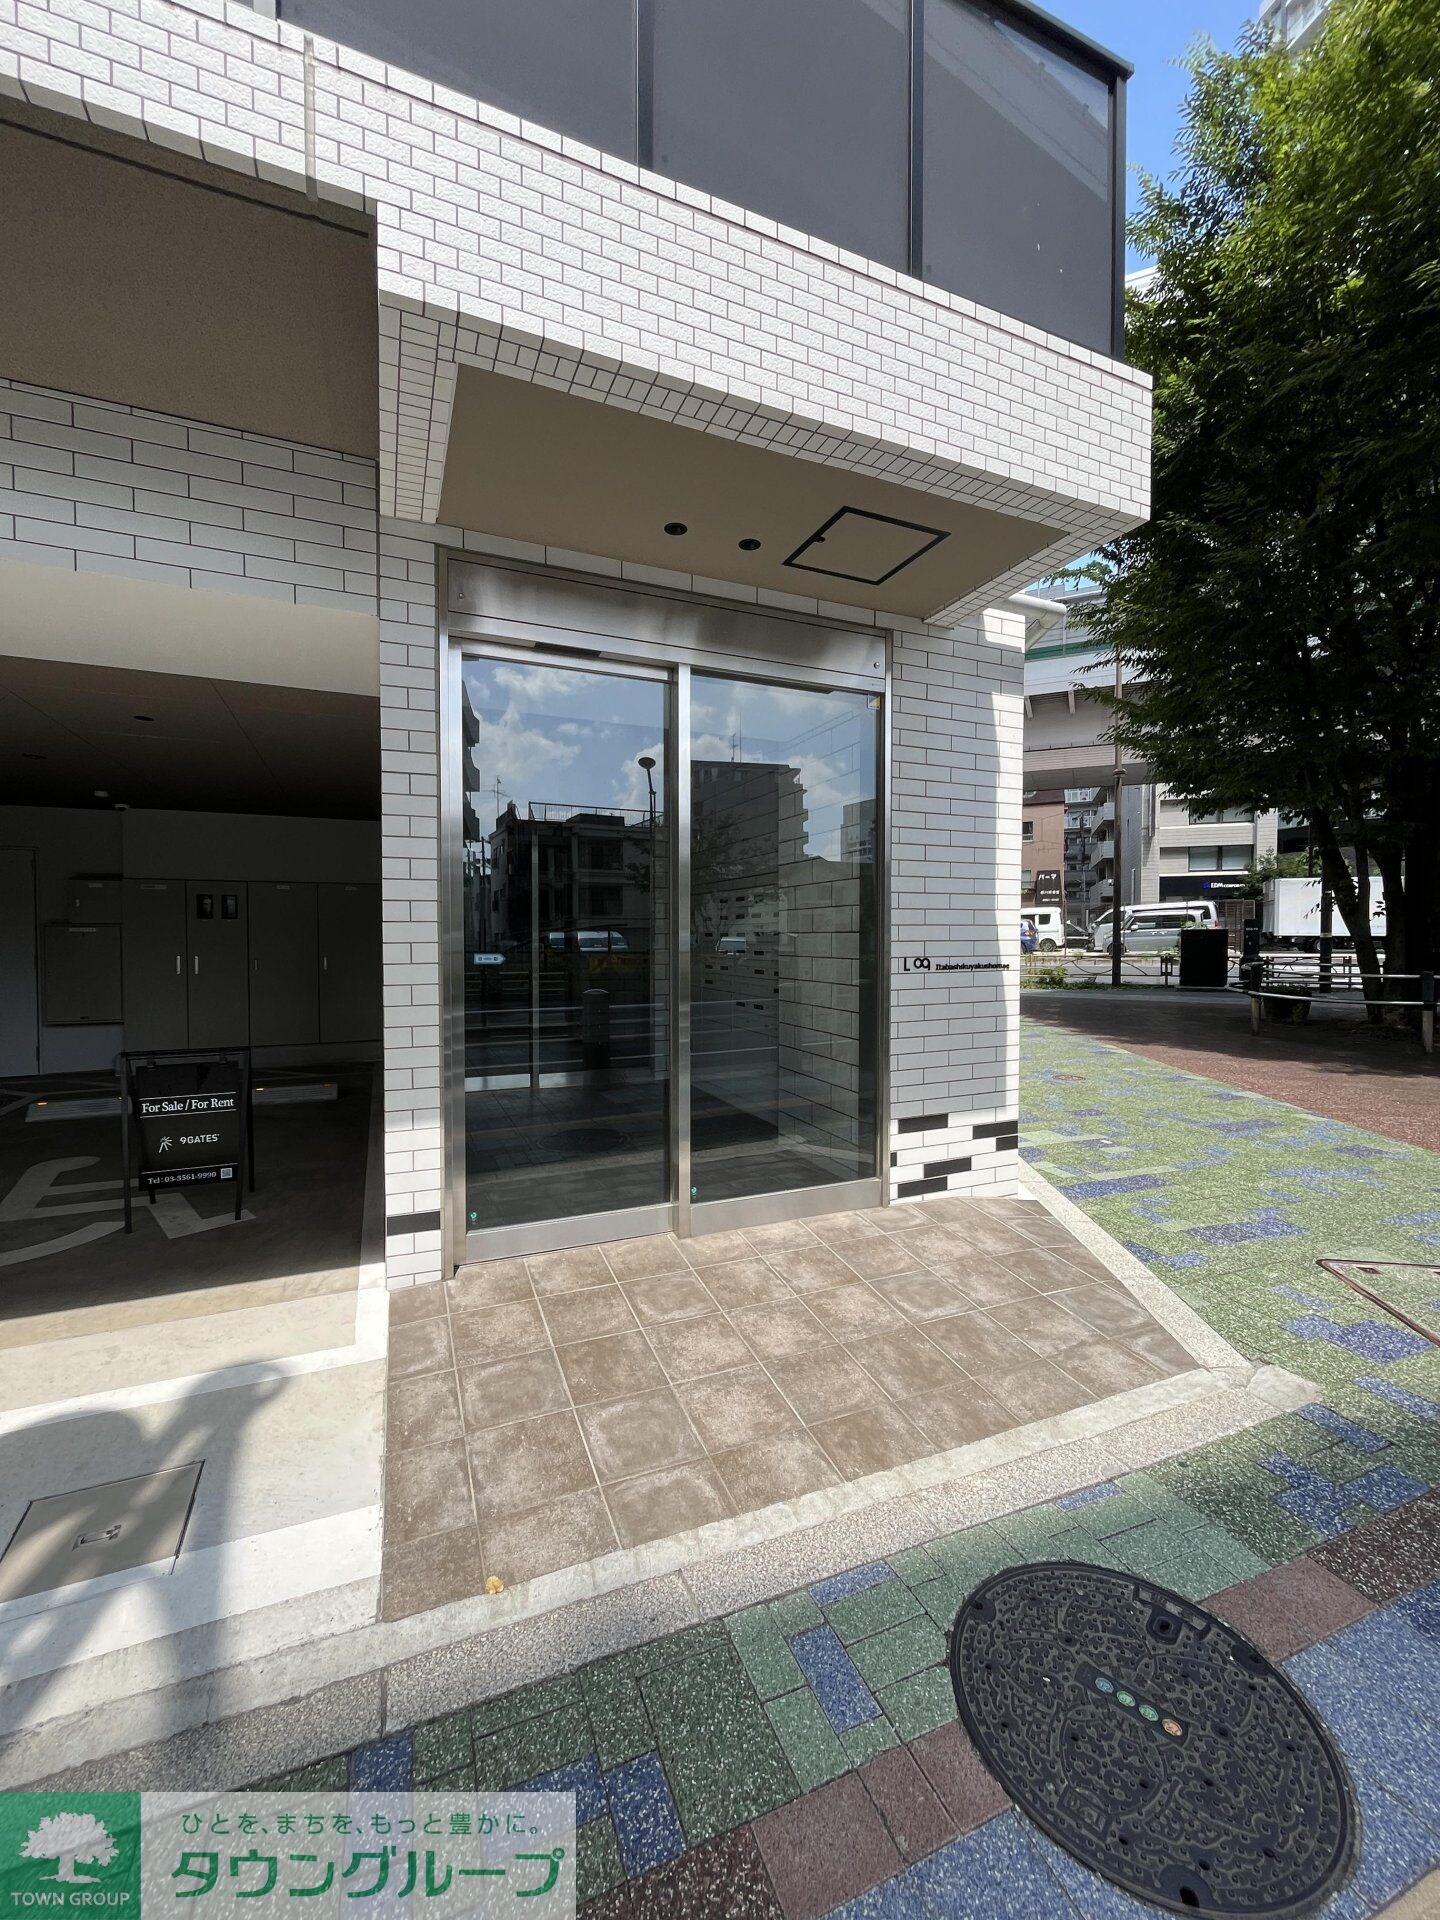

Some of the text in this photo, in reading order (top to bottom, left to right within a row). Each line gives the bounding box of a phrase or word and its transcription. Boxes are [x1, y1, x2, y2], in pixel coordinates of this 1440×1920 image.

[142, 1102, 161, 1113] For
[161, 1101, 184, 1112] Sale
[191, 1099, 209, 1110] For
[210, 1098, 235, 1108] Rent
[179, 1133, 219, 1145] 9GATES
